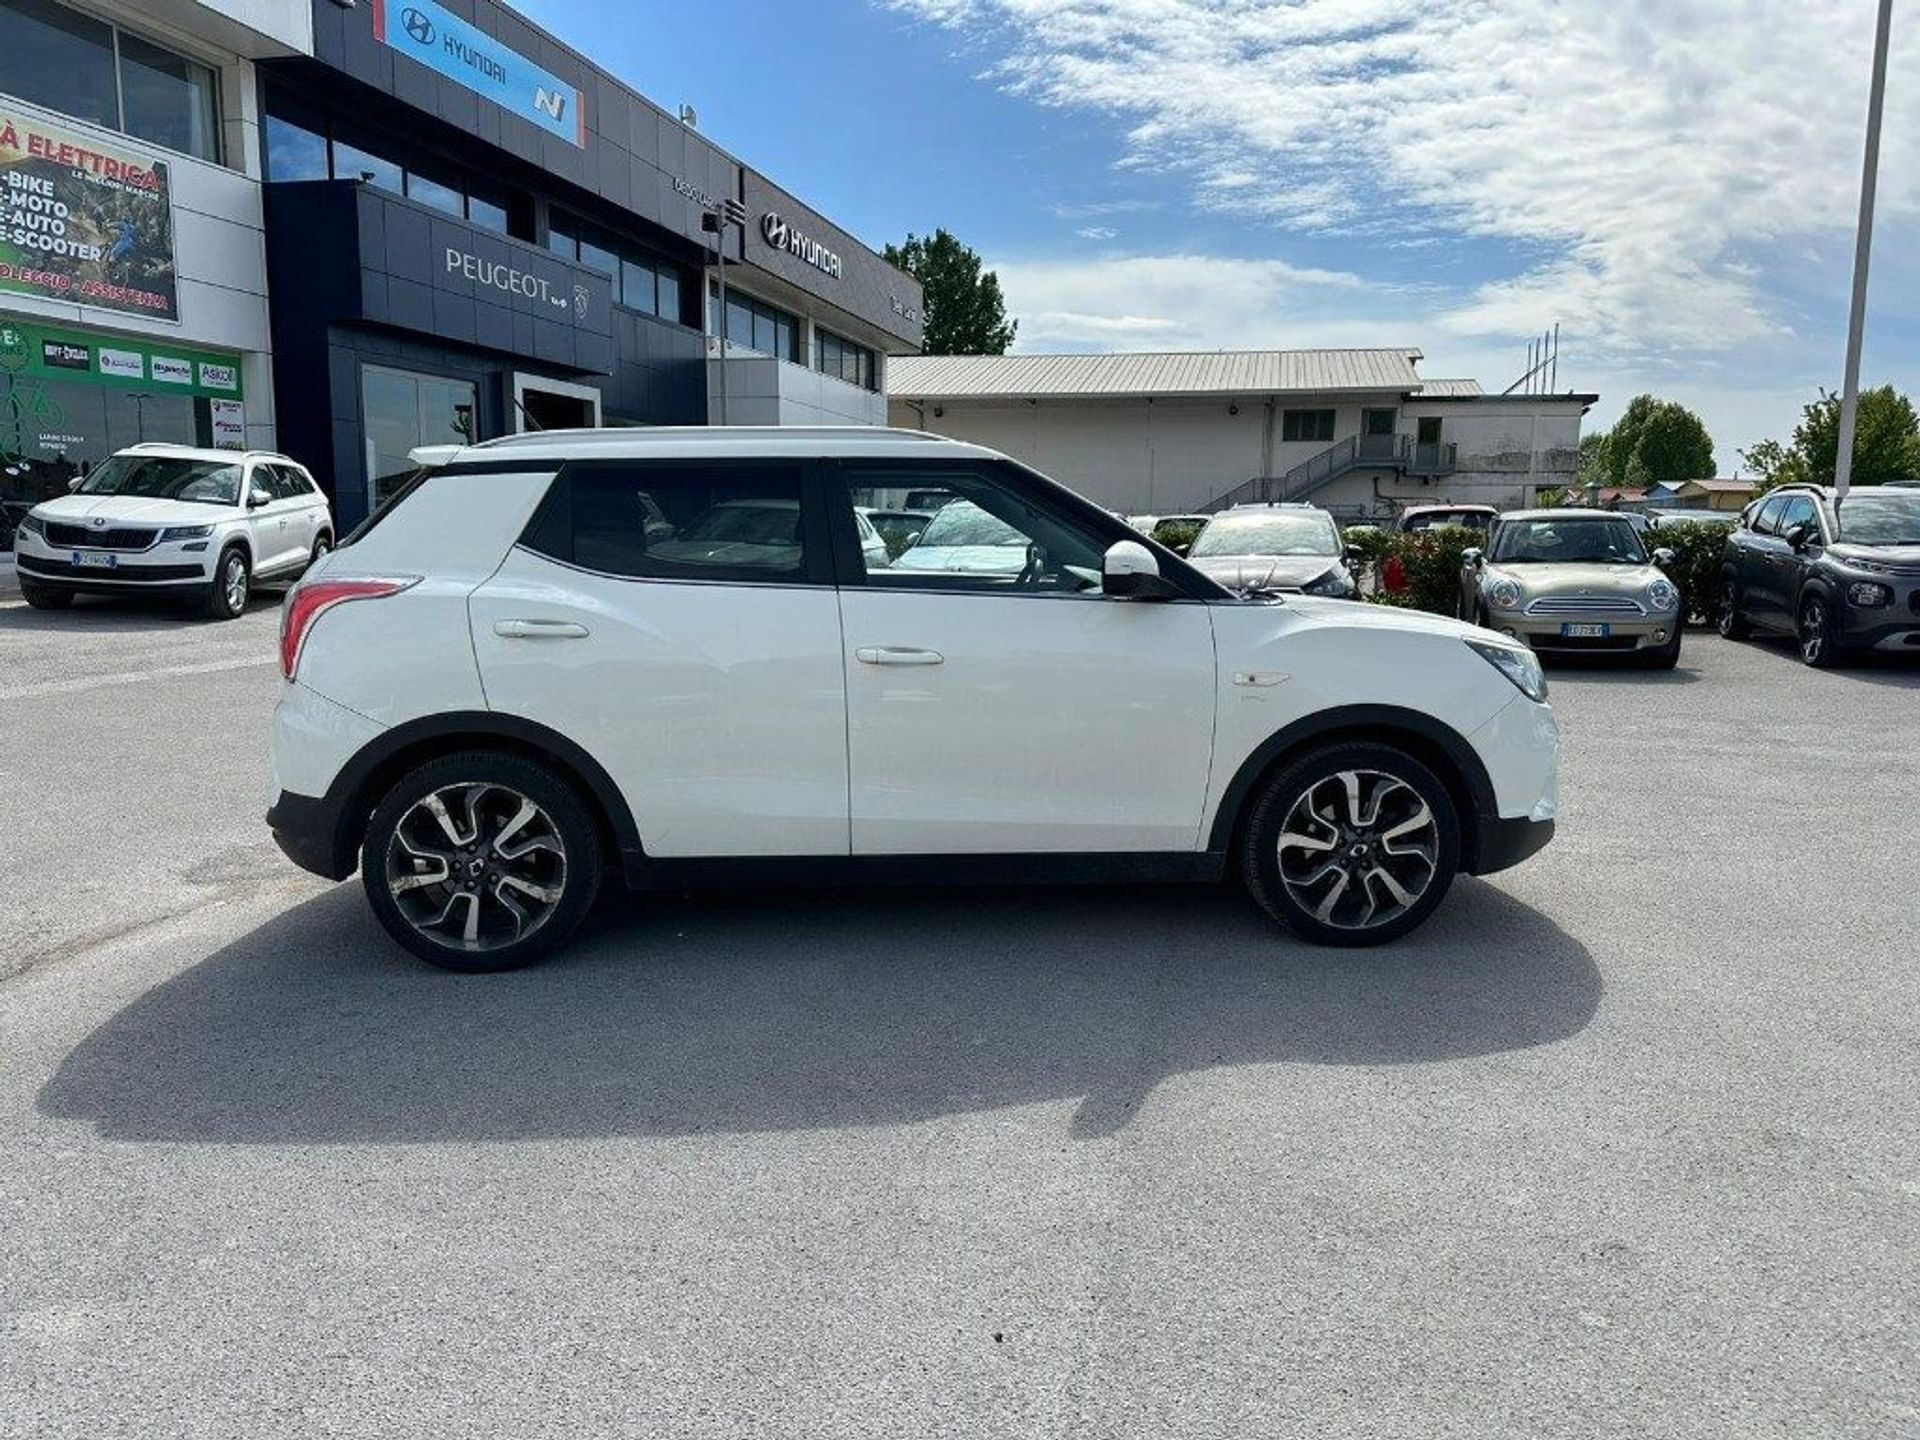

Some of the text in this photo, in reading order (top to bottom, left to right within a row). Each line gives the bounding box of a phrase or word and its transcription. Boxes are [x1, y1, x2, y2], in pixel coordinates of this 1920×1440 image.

[443, 33, 565, 122] HYUNDAI N
[27, 133, 160, 189] ELETTRICA
[0, 225, 101, 262] E-SCOOTER
[790, 229, 842, 279] HYUNDAI
[446, 247, 550, 301] PEUGEOT
